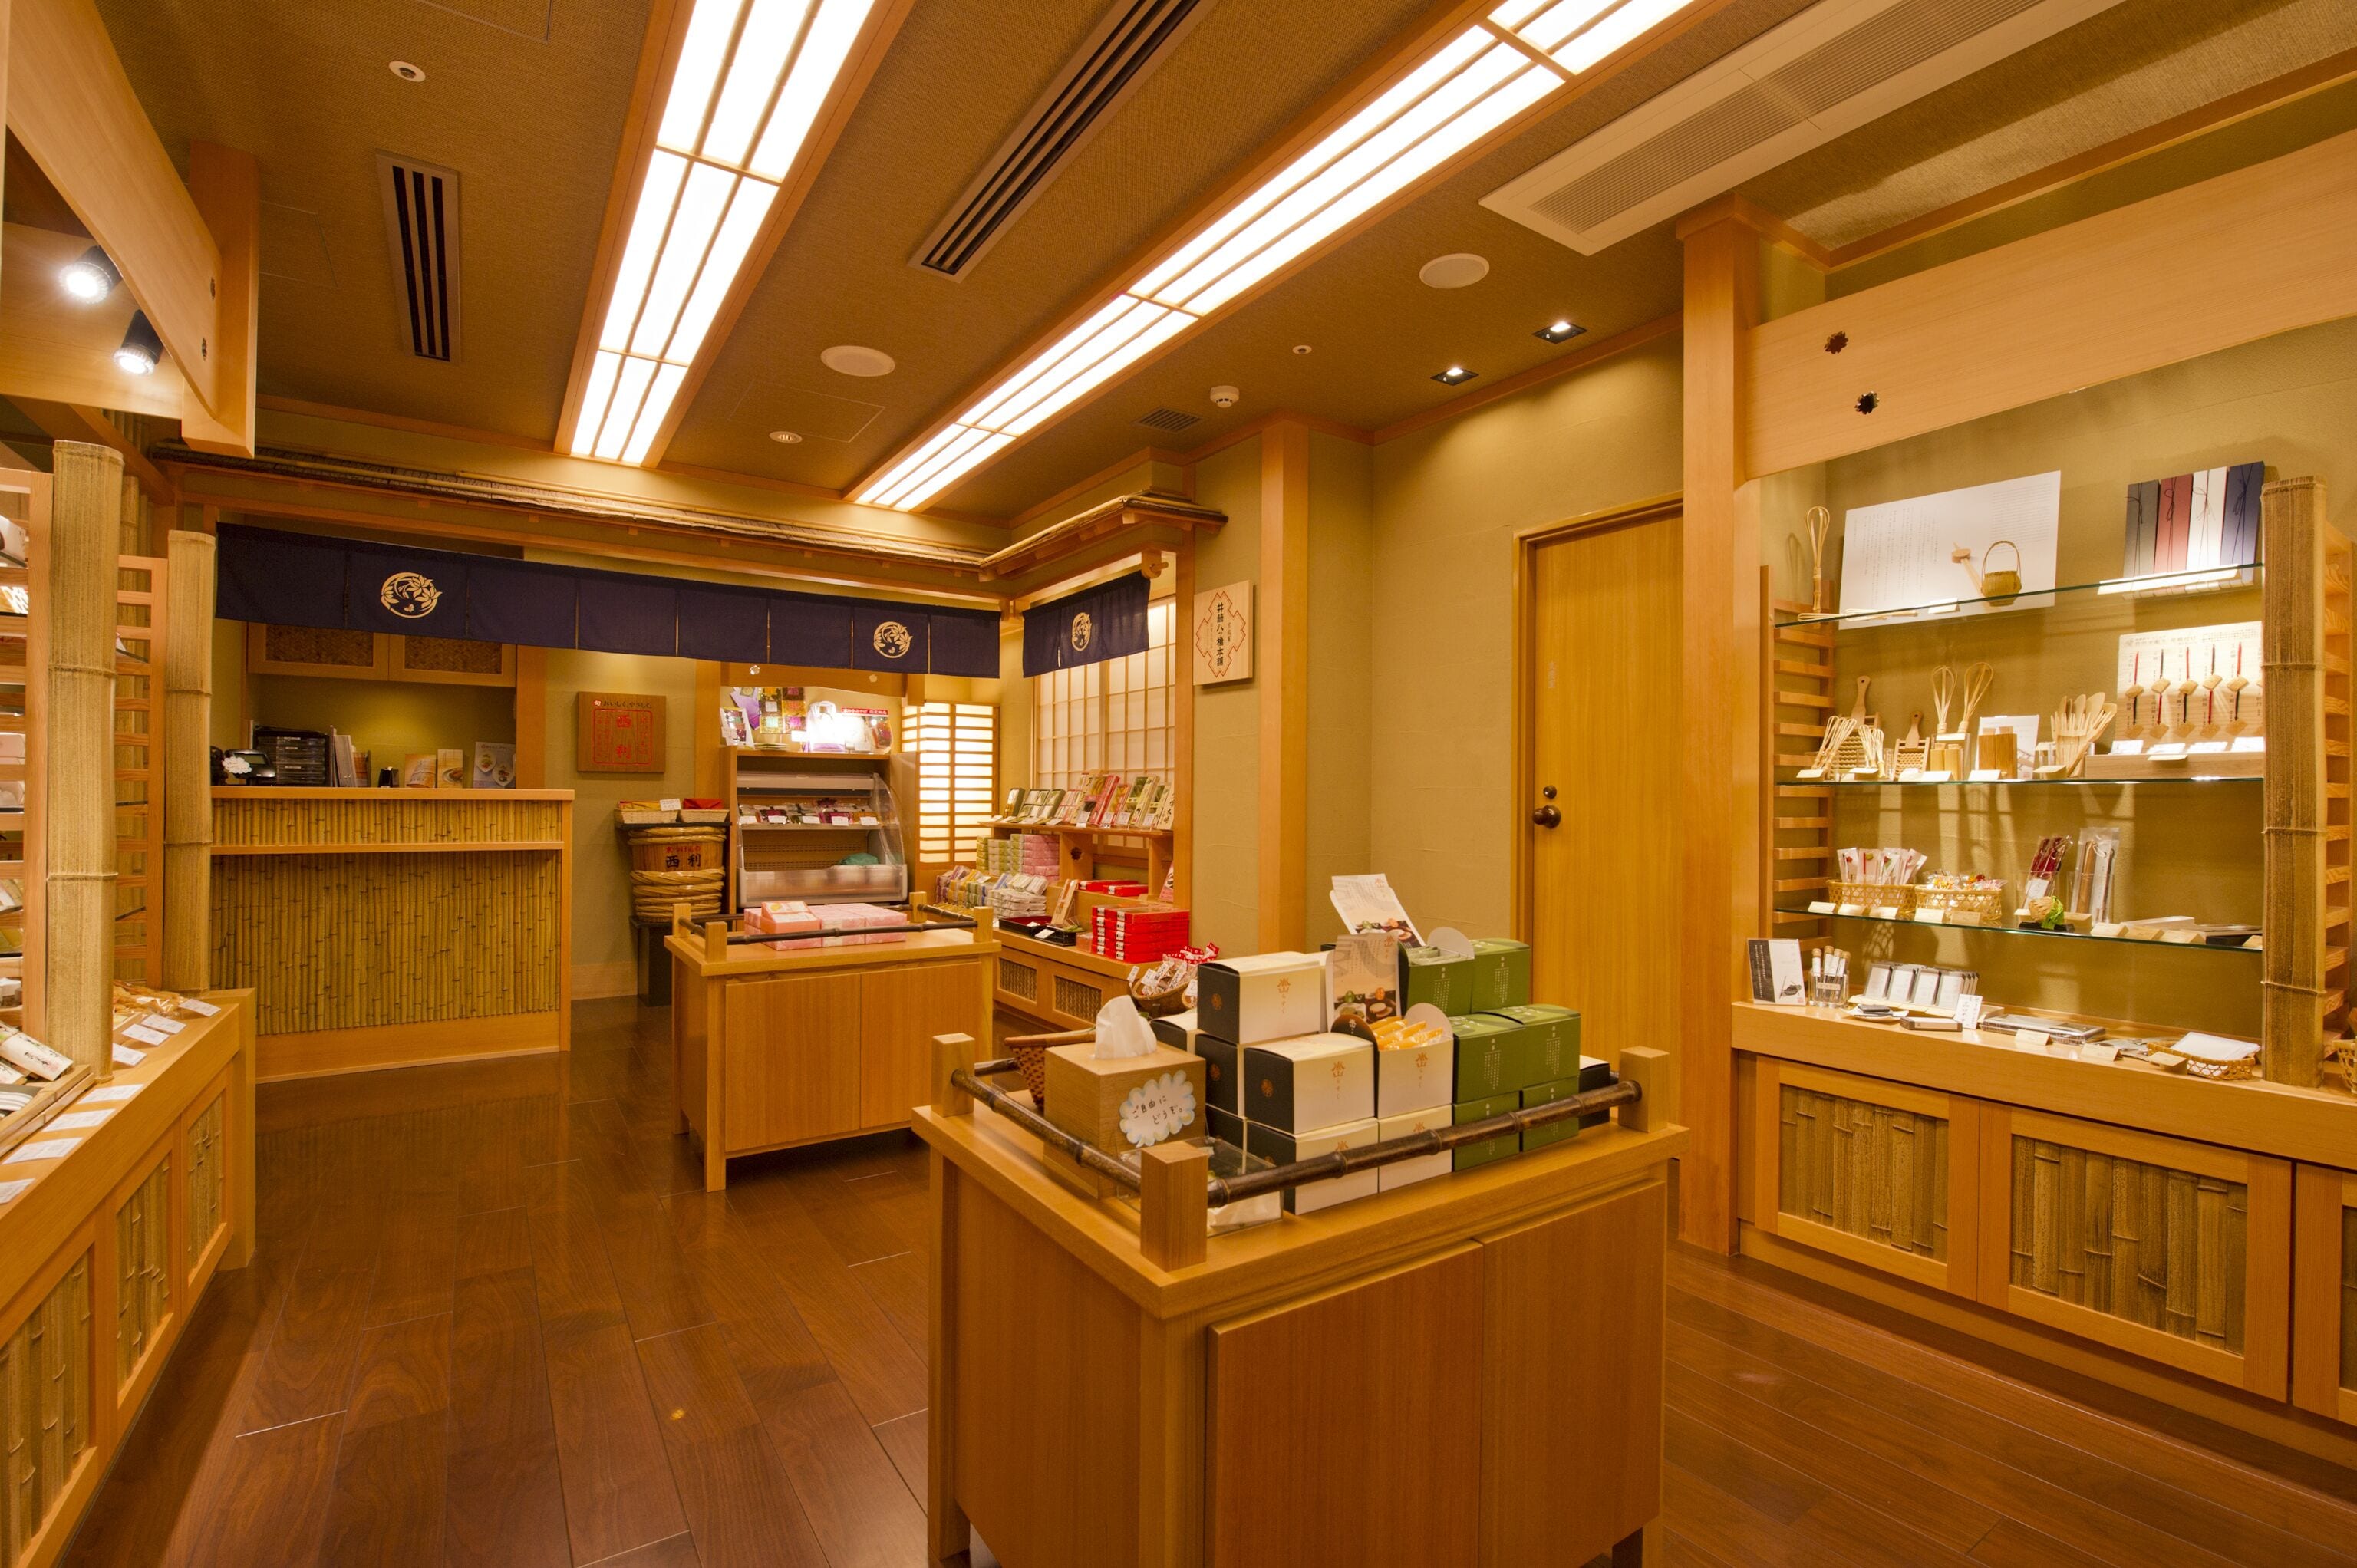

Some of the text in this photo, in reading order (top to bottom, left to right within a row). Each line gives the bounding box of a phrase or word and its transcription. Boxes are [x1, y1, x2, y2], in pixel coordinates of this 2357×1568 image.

[665, 853, 702, 868] 西利
[1132, 1095, 1167, 1119] ご自由に
